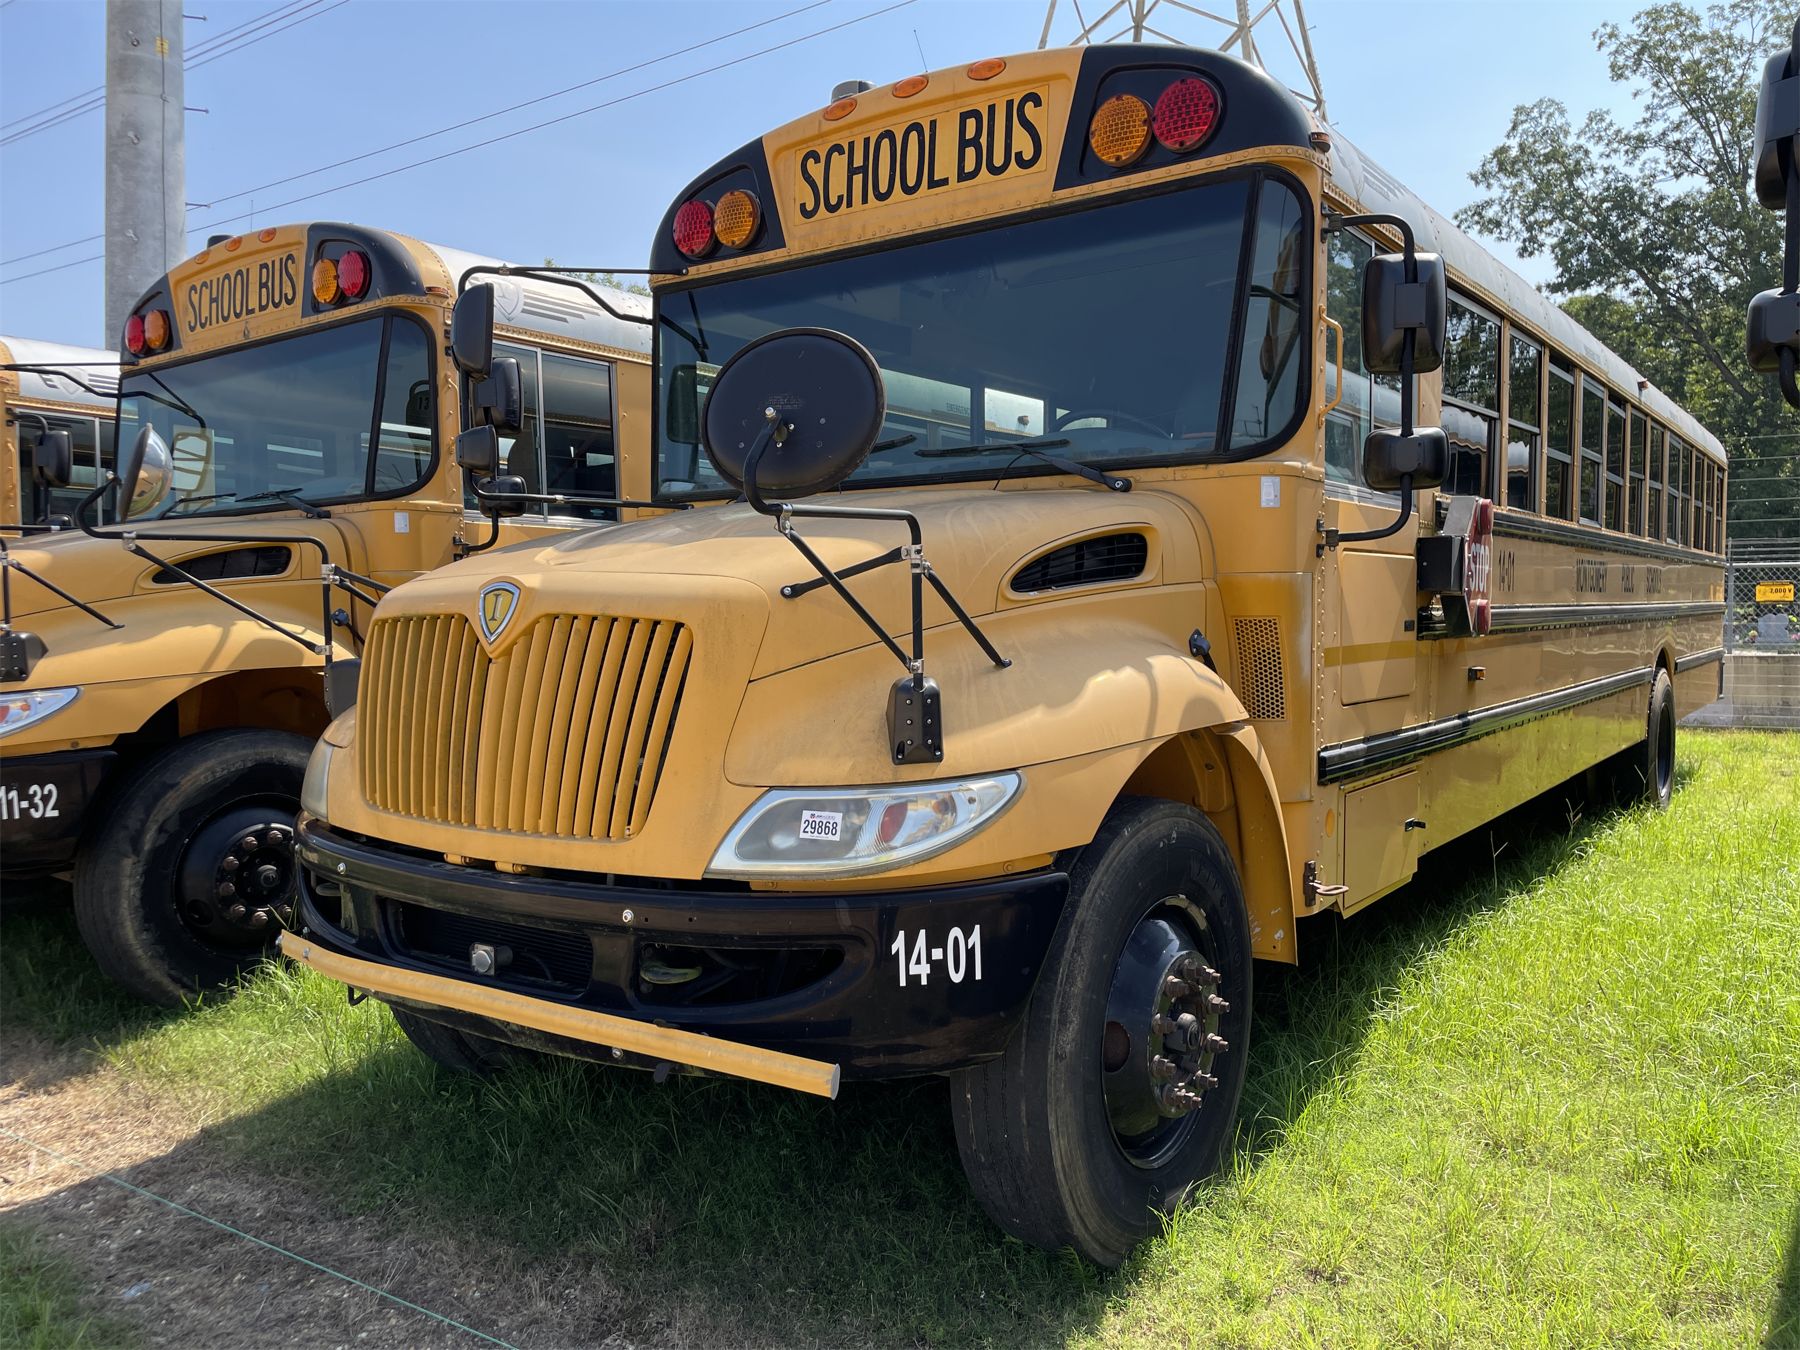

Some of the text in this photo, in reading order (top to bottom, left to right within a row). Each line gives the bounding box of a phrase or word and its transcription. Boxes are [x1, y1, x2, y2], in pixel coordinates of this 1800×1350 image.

[799, 91, 1043, 220] SCHOOL BUS
[187, 253, 297, 333] SCHOOL BUS
[1470, 542, 1490, 593] STOP
[1498, 550, 1515, 592] 14-01
[0, 783, 59, 820] 11-32
[803, 819, 838, 836] 29868
[891, 924, 982, 987] 14-01
